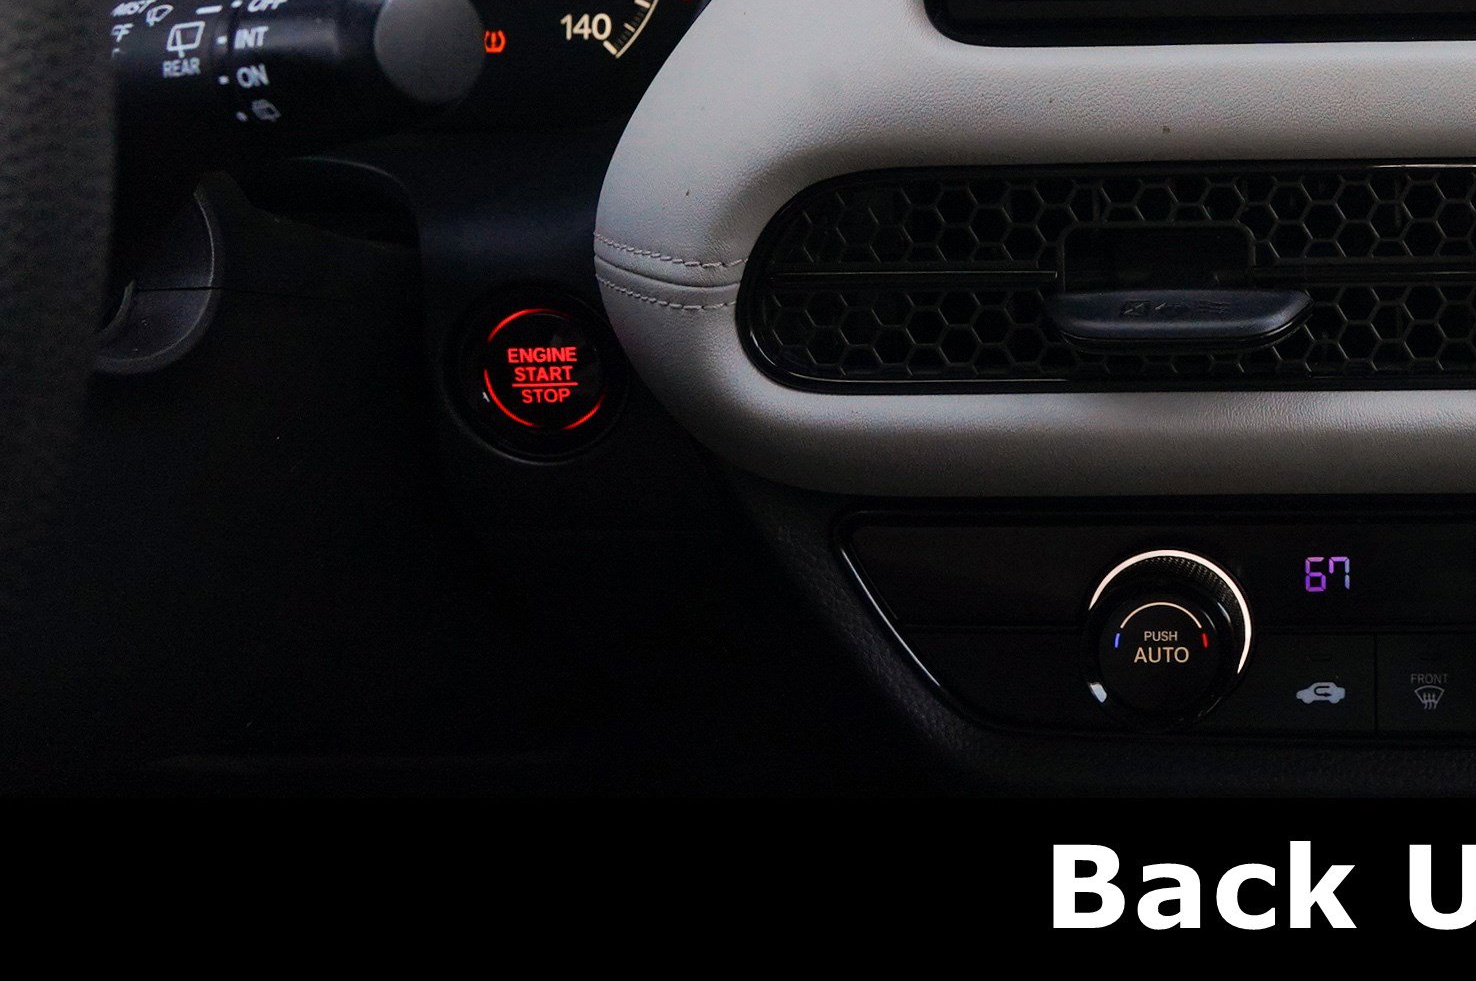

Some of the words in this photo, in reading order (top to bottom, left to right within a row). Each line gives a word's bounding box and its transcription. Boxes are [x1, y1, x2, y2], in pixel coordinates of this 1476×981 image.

[560, 13, 612, 41] 140
[234, 25, 269, 49] INT
[162, 58, 200, 78] REAR
[236, 64, 269, 88] ON
[507, 346, 577, 363] ENGINE
[514, 366, 573, 381] START
[521, 388, 571, 403] STOP
[1304, 556, 1350, 592] 67
[1143, 630, 1178, 642] PUSH
[1133, 646, 1190, 664] AUTO
[1410, 673, 1448, 685] FRONT
